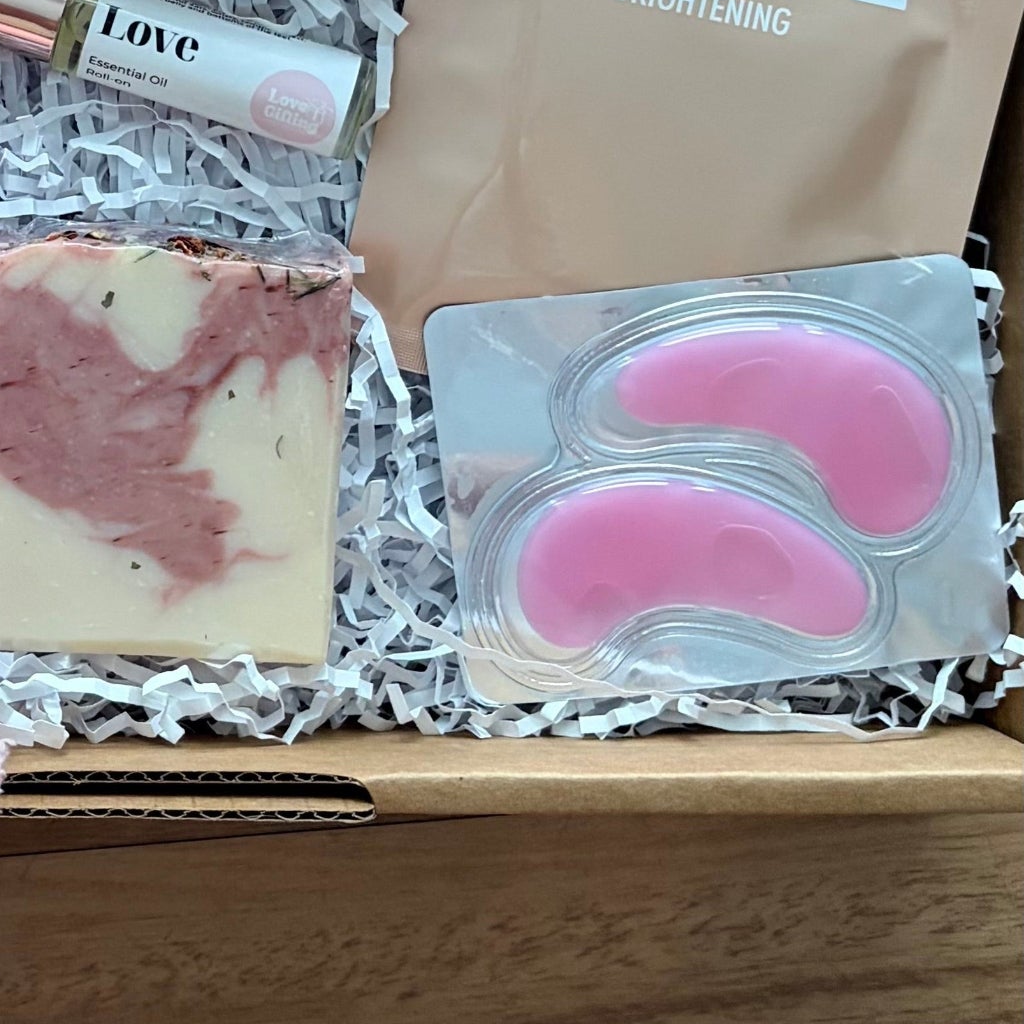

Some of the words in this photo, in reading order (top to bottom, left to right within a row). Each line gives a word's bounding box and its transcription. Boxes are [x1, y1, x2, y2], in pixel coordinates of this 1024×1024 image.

[97, 3, 199, 62] Love
[86, 68, 131, 88] Roll-on
[88, 55, 147, 81] Essential
[149, 75, 168, 88] Oil
[268, 87, 309, 114] Love
